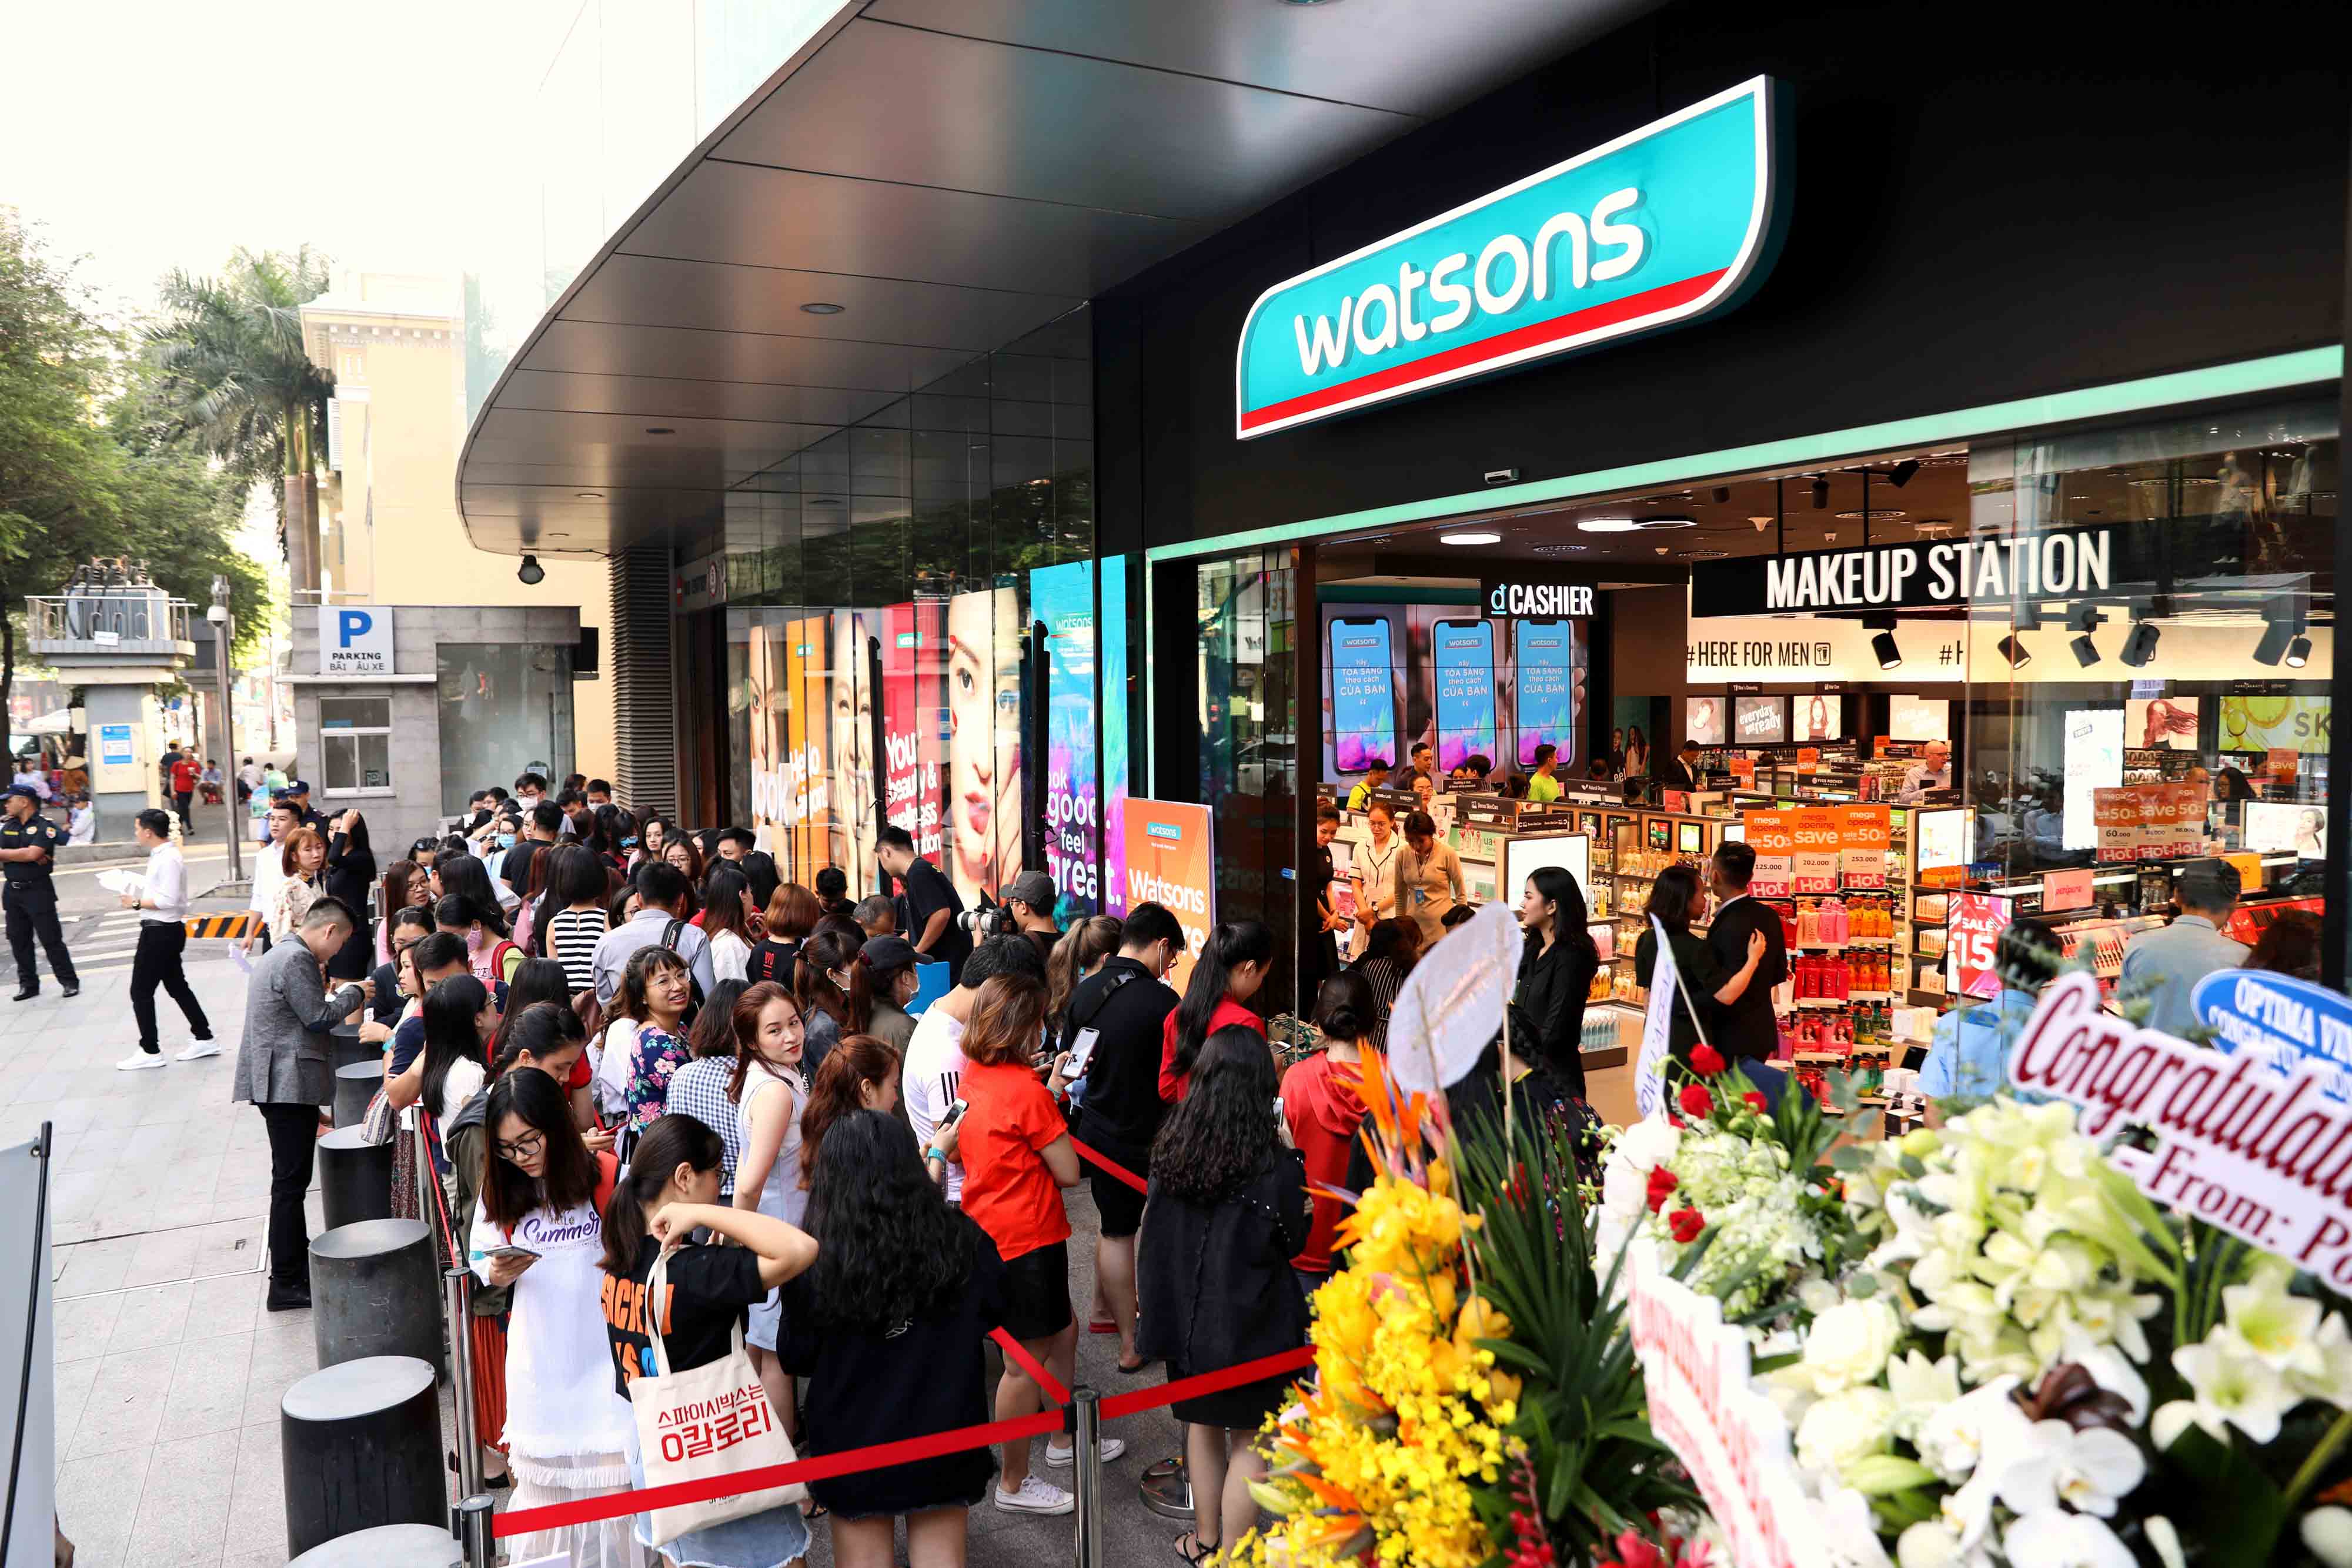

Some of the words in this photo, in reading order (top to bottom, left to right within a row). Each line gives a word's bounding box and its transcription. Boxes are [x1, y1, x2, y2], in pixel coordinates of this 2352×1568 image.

[1294, 186, 1645, 376] watsons
[1766, 547, 1919, 609] MAKEUP
[1927, 530, 2111, 600] STATION
[1509, 584, 1594, 615] CASHIER
[339, 610, 372, 648] P
[1055, 617, 1092, 631] watsons
[1743, 641, 1772, 667] FOR
[1778, 641, 1809, 667] MEN
[330, 661, 346, 671] BÃI
[1739, 705, 1773, 725] everyday
[885, 728, 922, 774] You
[1799, 761, 1816, 770] save
[2270, 761, 2296, 770] save
[888, 768, 926, 804] beauy
[927, 760, 937, 790] &
[1849, 811, 1875, 820] mega
[2139, 805, 2175, 817] save
[1753, 817, 1780, 825] mega
[1798, 822, 1835, 830] opening
[1847, 819, 1884, 827] opening
[1150, 825, 1177, 837] watsons
[1750, 825, 1788, 834] opening
[2106, 830, 2131, 838] 60.000
[1061, 827, 1085, 855] feel
[1794, 830, 1839, 845] save
[2103, 849, 2133, 861] Hot
[1047, 854, 1122, 907] great.
[1800, 877, 1833, 892] Hot
[1849, 872, 1881, 887] Hot
[1128, 868, 1205, 915] Watsons
[1752, 882, 1785, 897] Hot
[1962, 917, 1994, 931] SALE
[1952, 931, 1995, 971] 15
[2234, 977, 2316, 1048] OPTIMA
[2149, 1145, 2294, 1246] From:
[523, 1211, 600, 1242] Summer
[658, 1383, 764, 1430] 스파이시박스는
